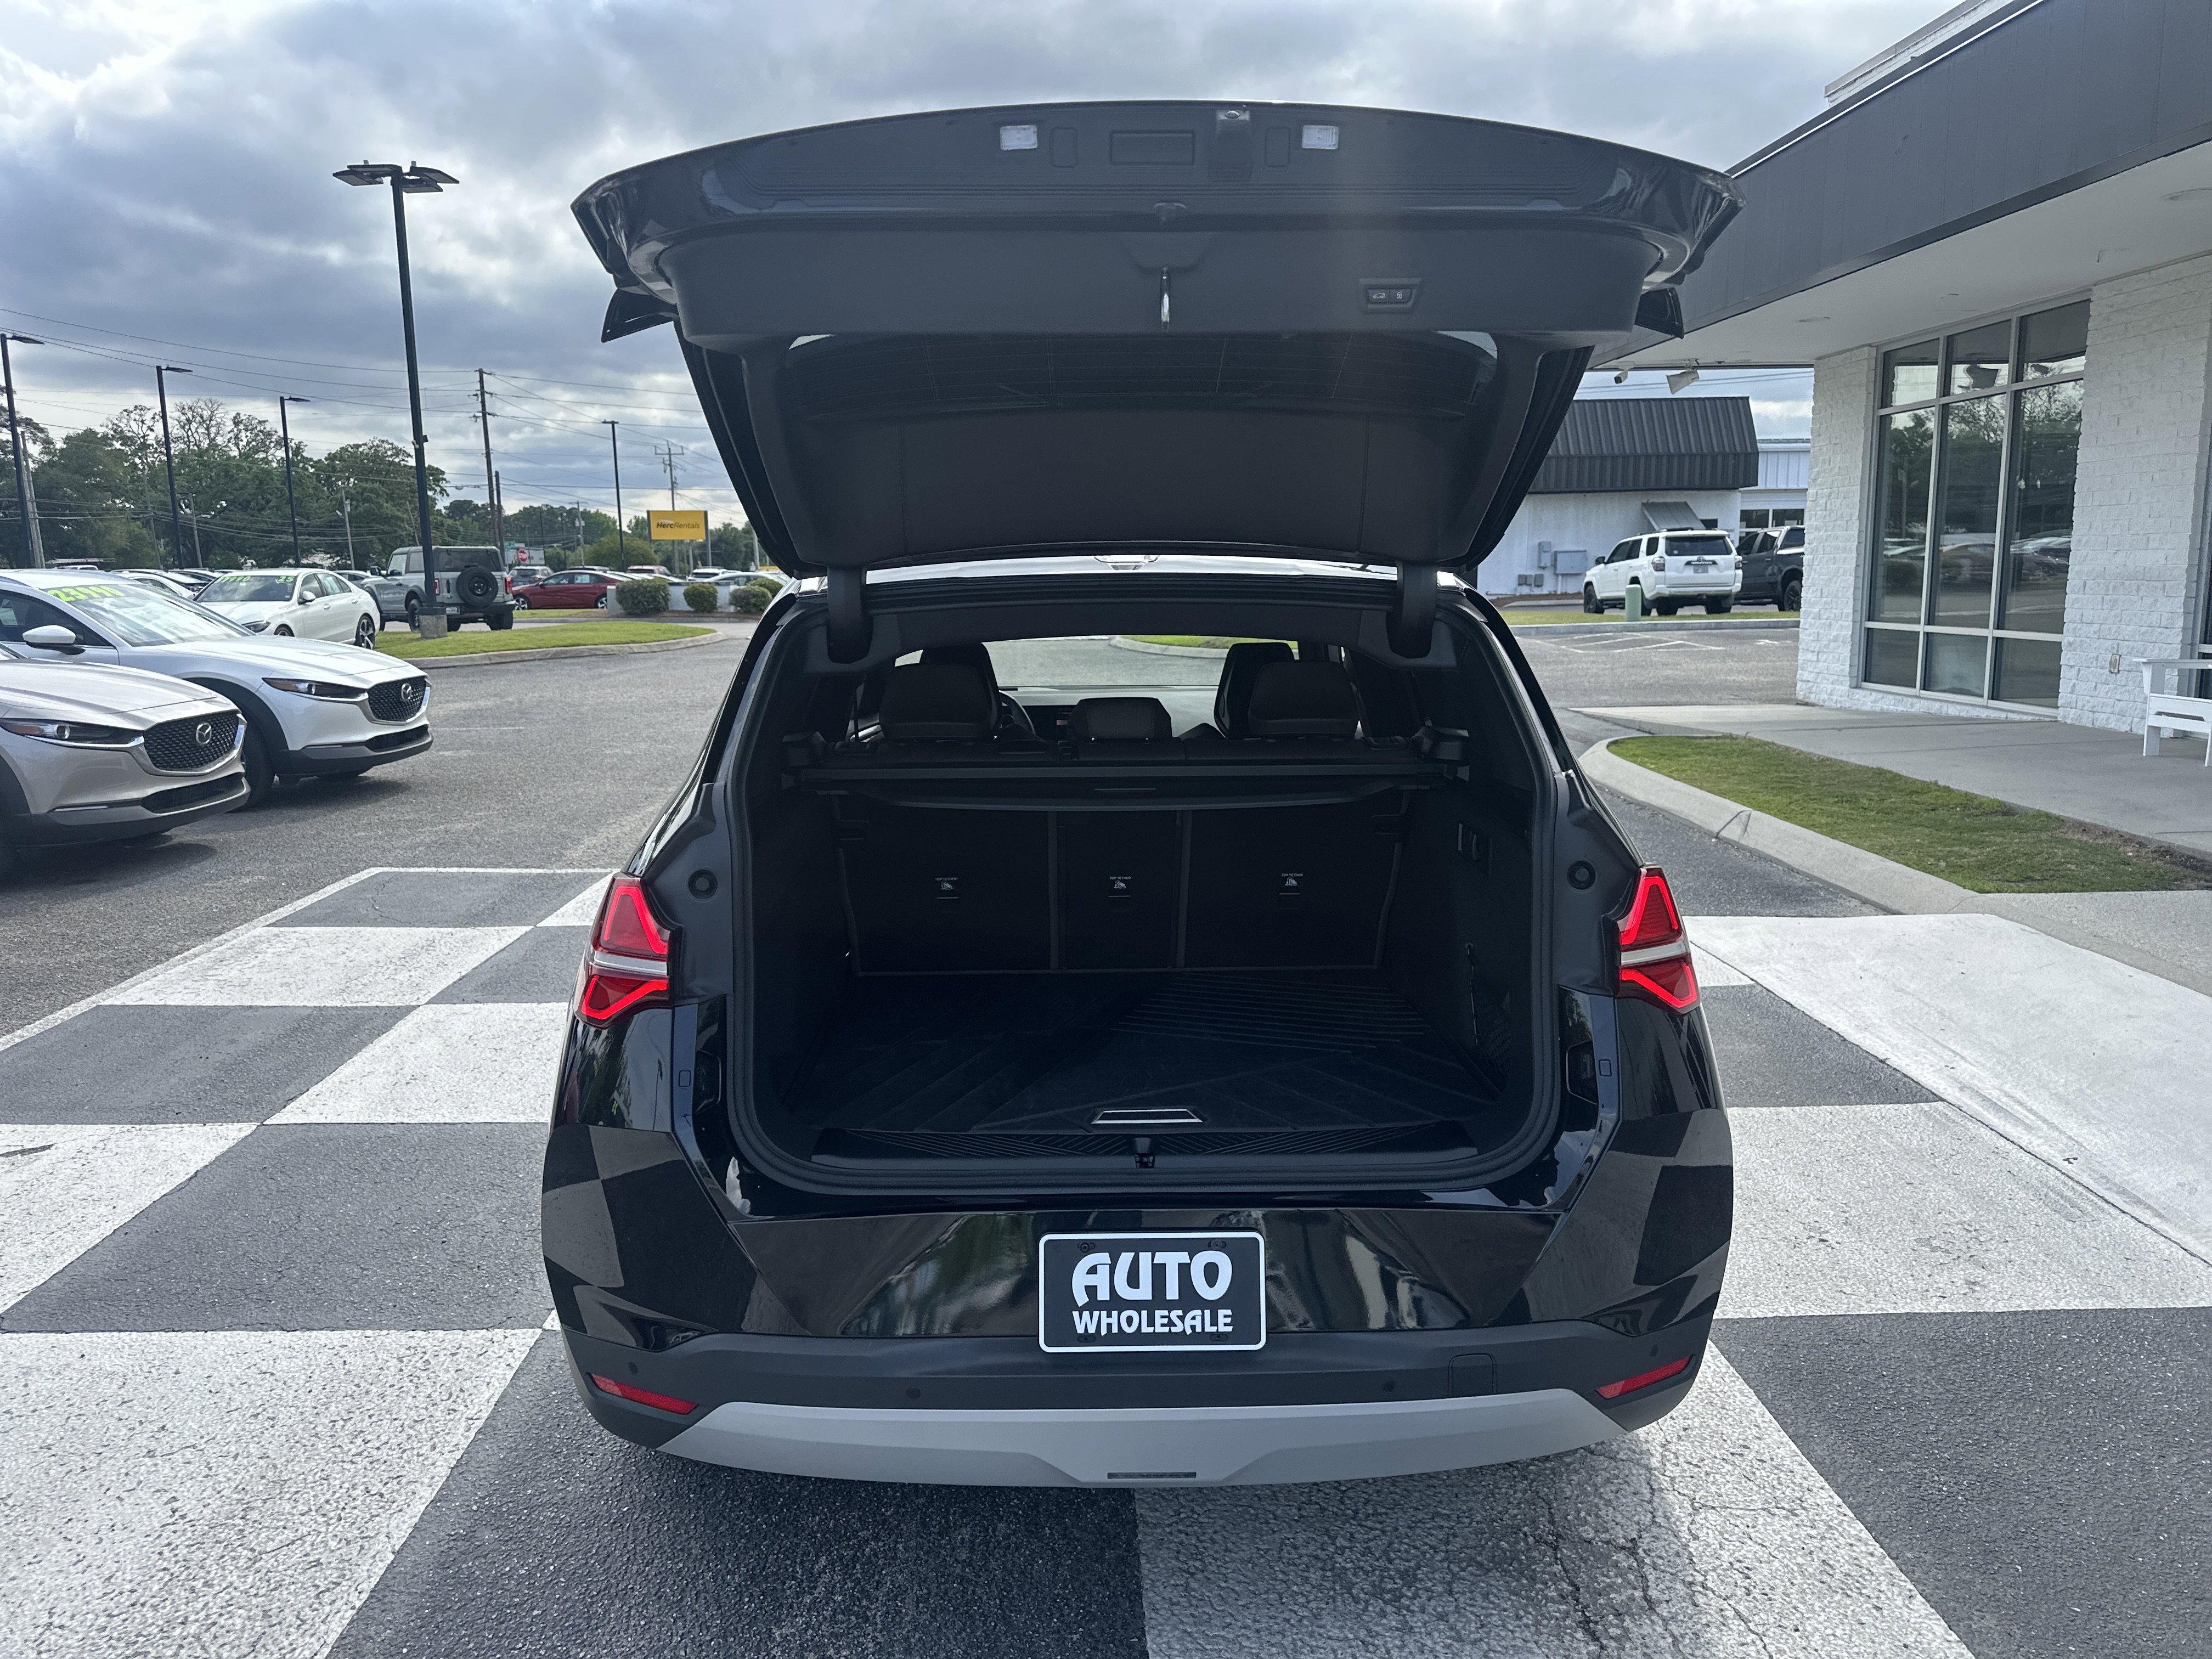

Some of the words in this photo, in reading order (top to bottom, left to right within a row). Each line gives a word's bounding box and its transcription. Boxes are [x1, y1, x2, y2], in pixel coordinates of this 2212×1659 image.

[47, 585, 126, 602] 23990
[1072, 1250, 1232, 1307] AUTO
[1072, 1310, 1233, 1336] WHOLESALE
